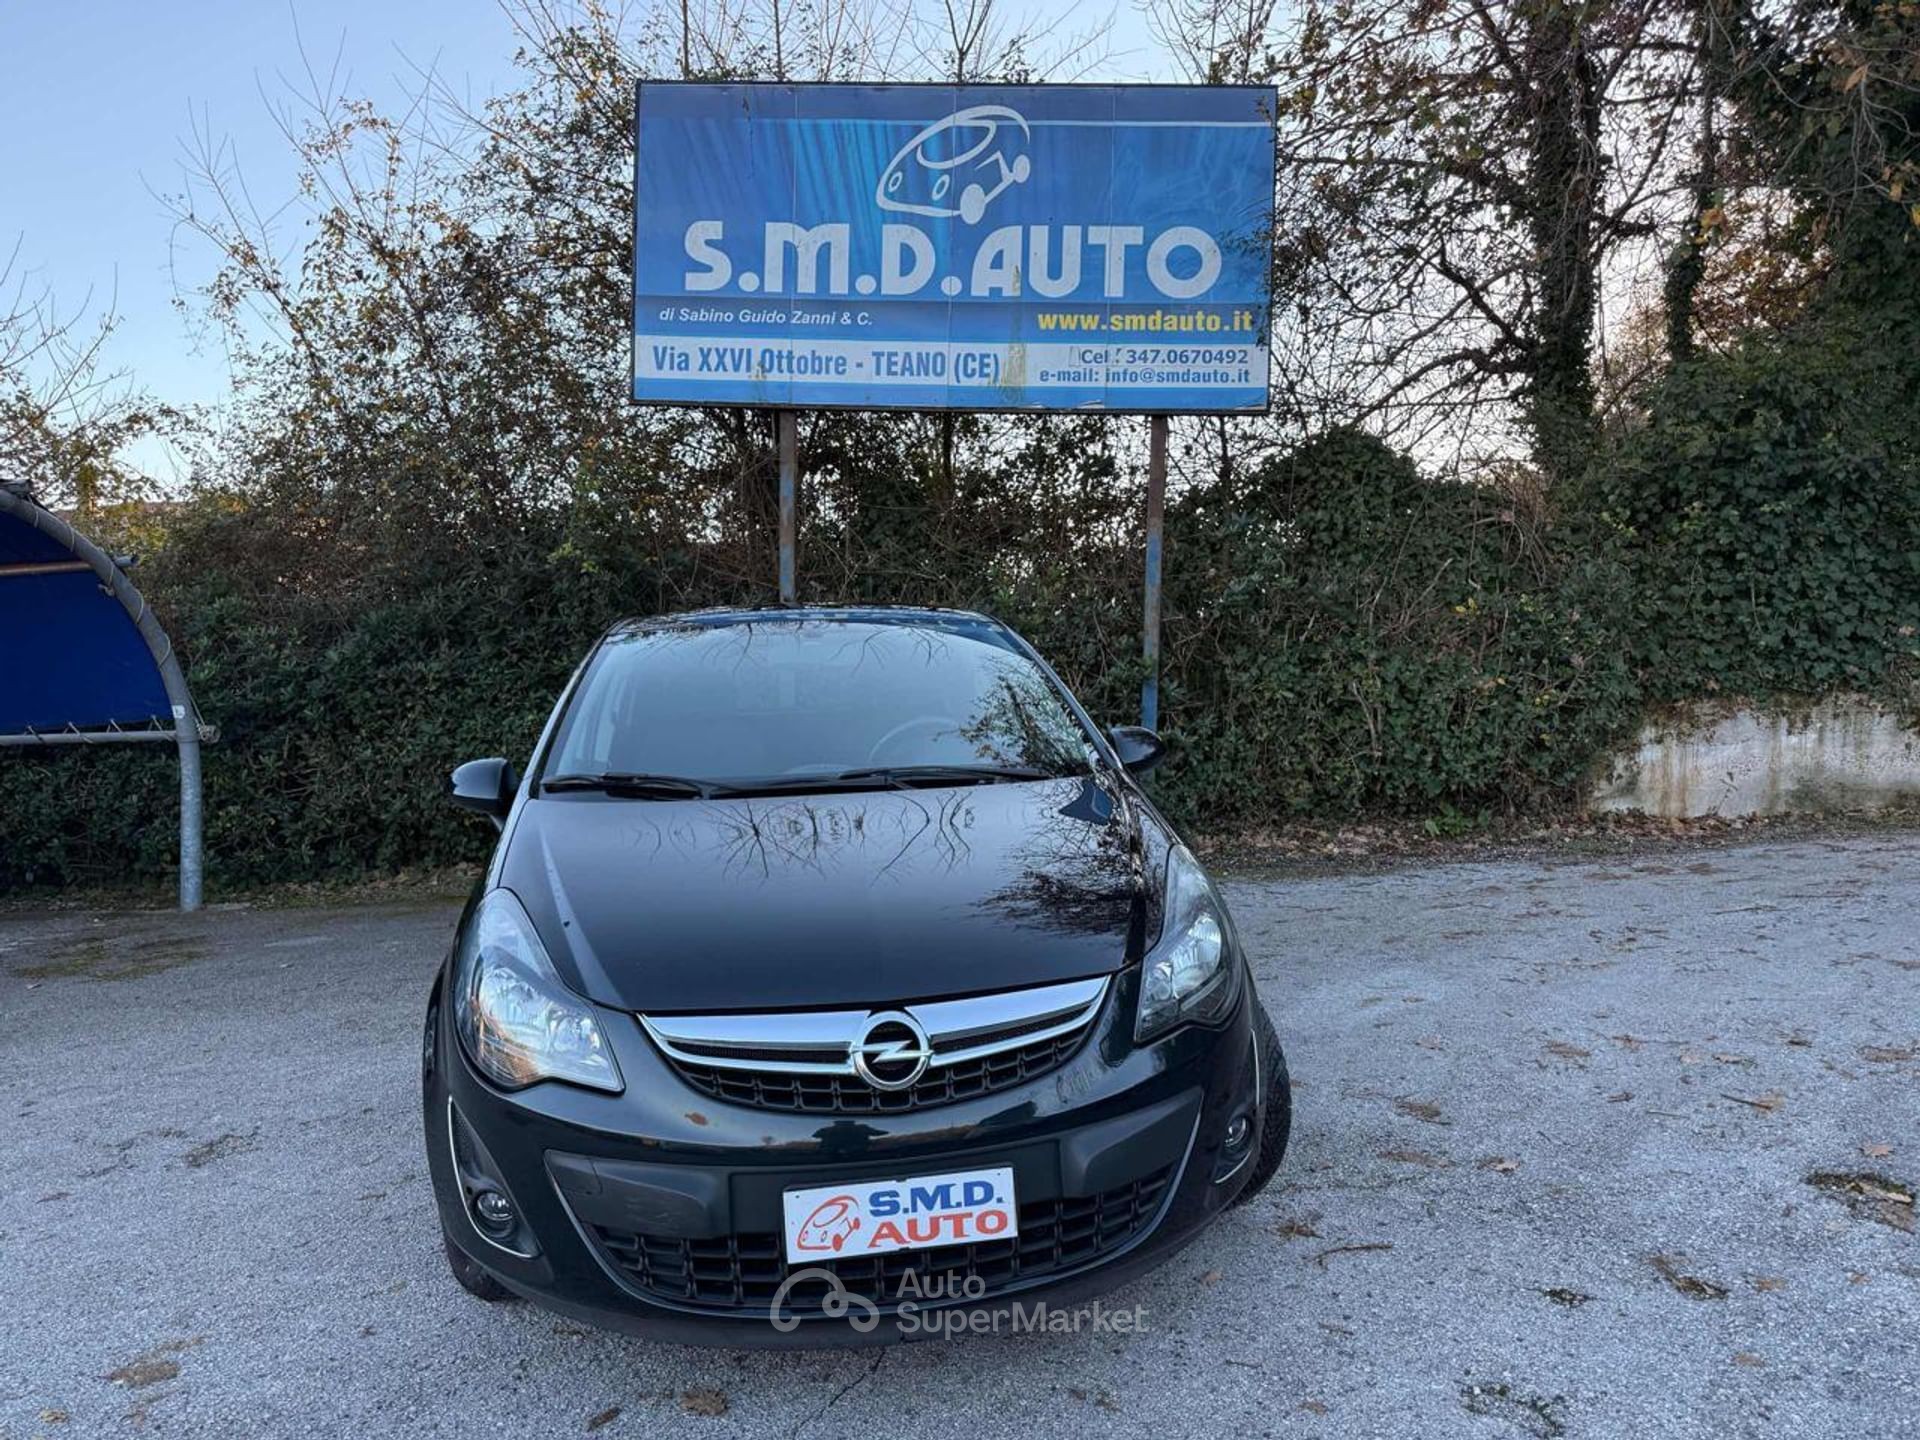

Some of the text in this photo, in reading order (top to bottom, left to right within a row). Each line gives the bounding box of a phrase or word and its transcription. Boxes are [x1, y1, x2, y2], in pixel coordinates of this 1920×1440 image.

[659, 307, 873, 326] di Sabino Guido Zanni & C.
[1038, 310, 1253, 332] www.smdauto.it
[653, 346, 690, 371] Via
[699, 348, 750, 373] XXVI
[760, 348, 847, 375] Ottobre
[872, 351, 946, 377] TEANO
[954, 353, 999, 383] (CE)
[1126, 349, 1248, 365] 347.0670492
[1039, 368, 1250, 383] e-mail: info@smdauto.it
[869, 1180, 1003, 1217] S.M.D.
[867, 1210, 1008, 1249] AUTO
